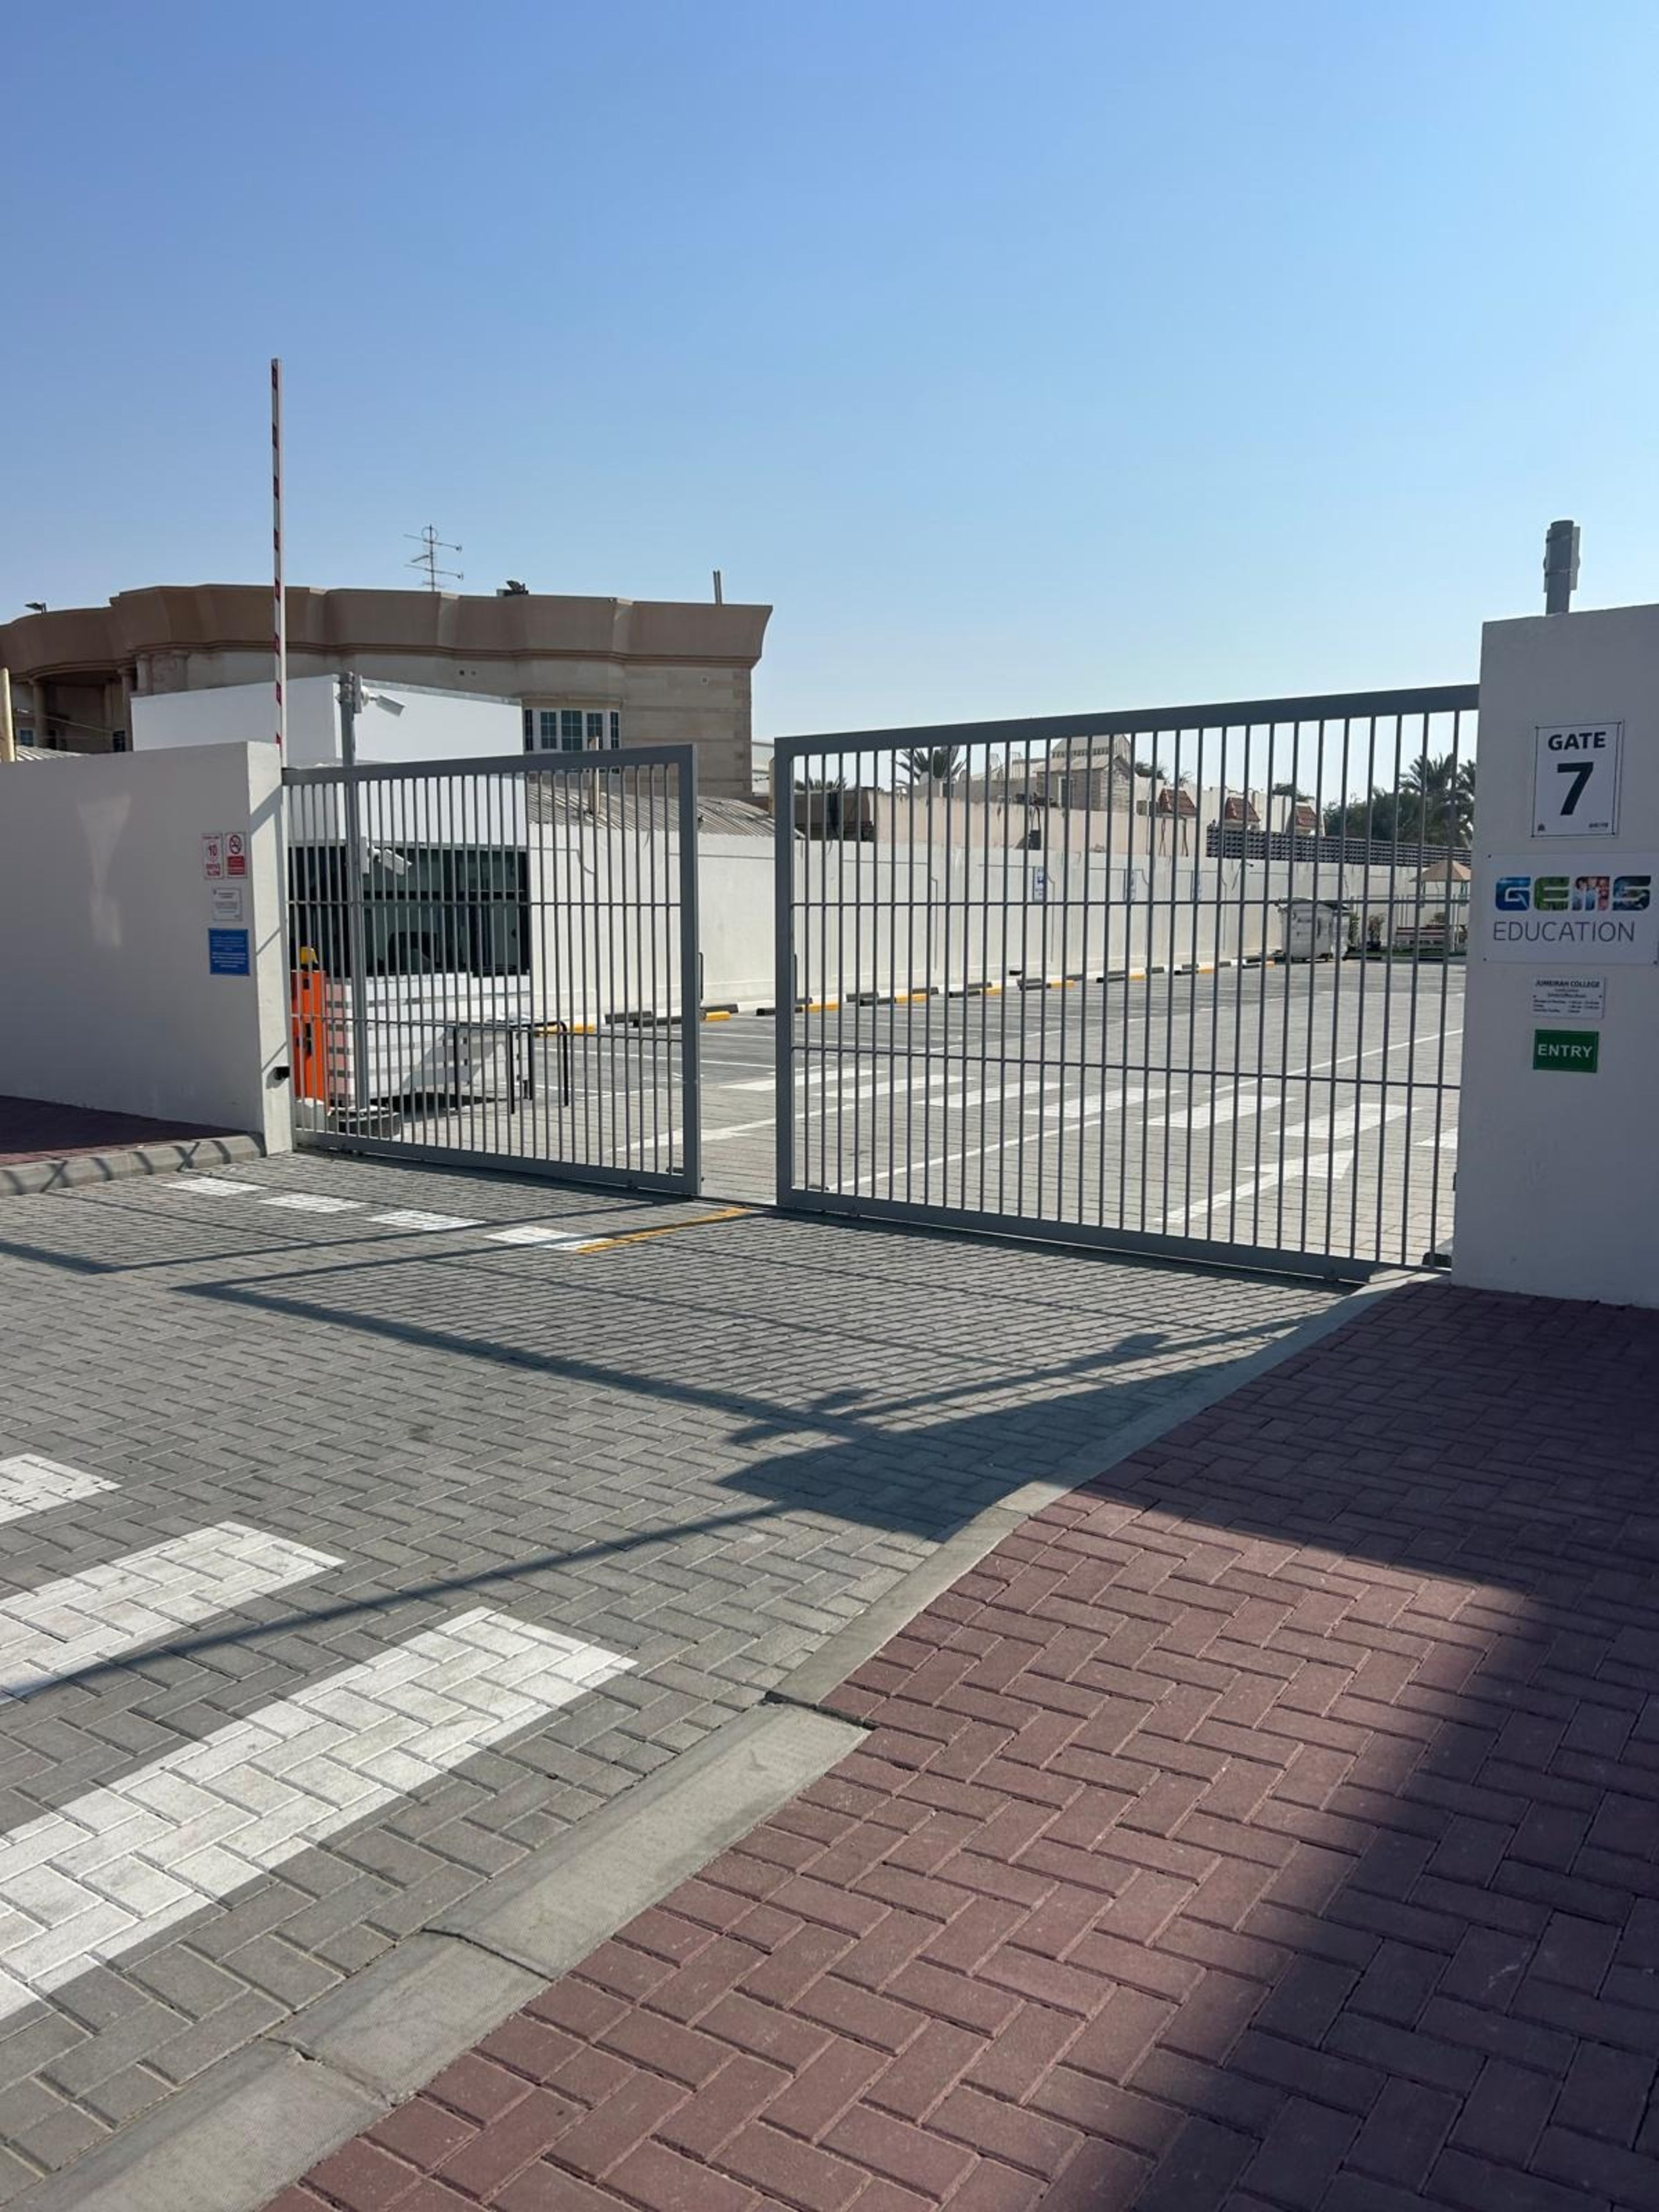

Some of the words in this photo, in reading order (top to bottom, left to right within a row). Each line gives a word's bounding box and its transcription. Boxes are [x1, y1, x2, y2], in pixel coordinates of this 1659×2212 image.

[1548, 732, 1606, 751] GATE
[1557, 762, 1594, 816] 7
[208, 845, 217, 856] 10
[1495, 876, 1652, 912] GEMS
[1493, 921, 1635, 943] EDUCATION
[1538, 1043, 1592, 1058] ENTRY
